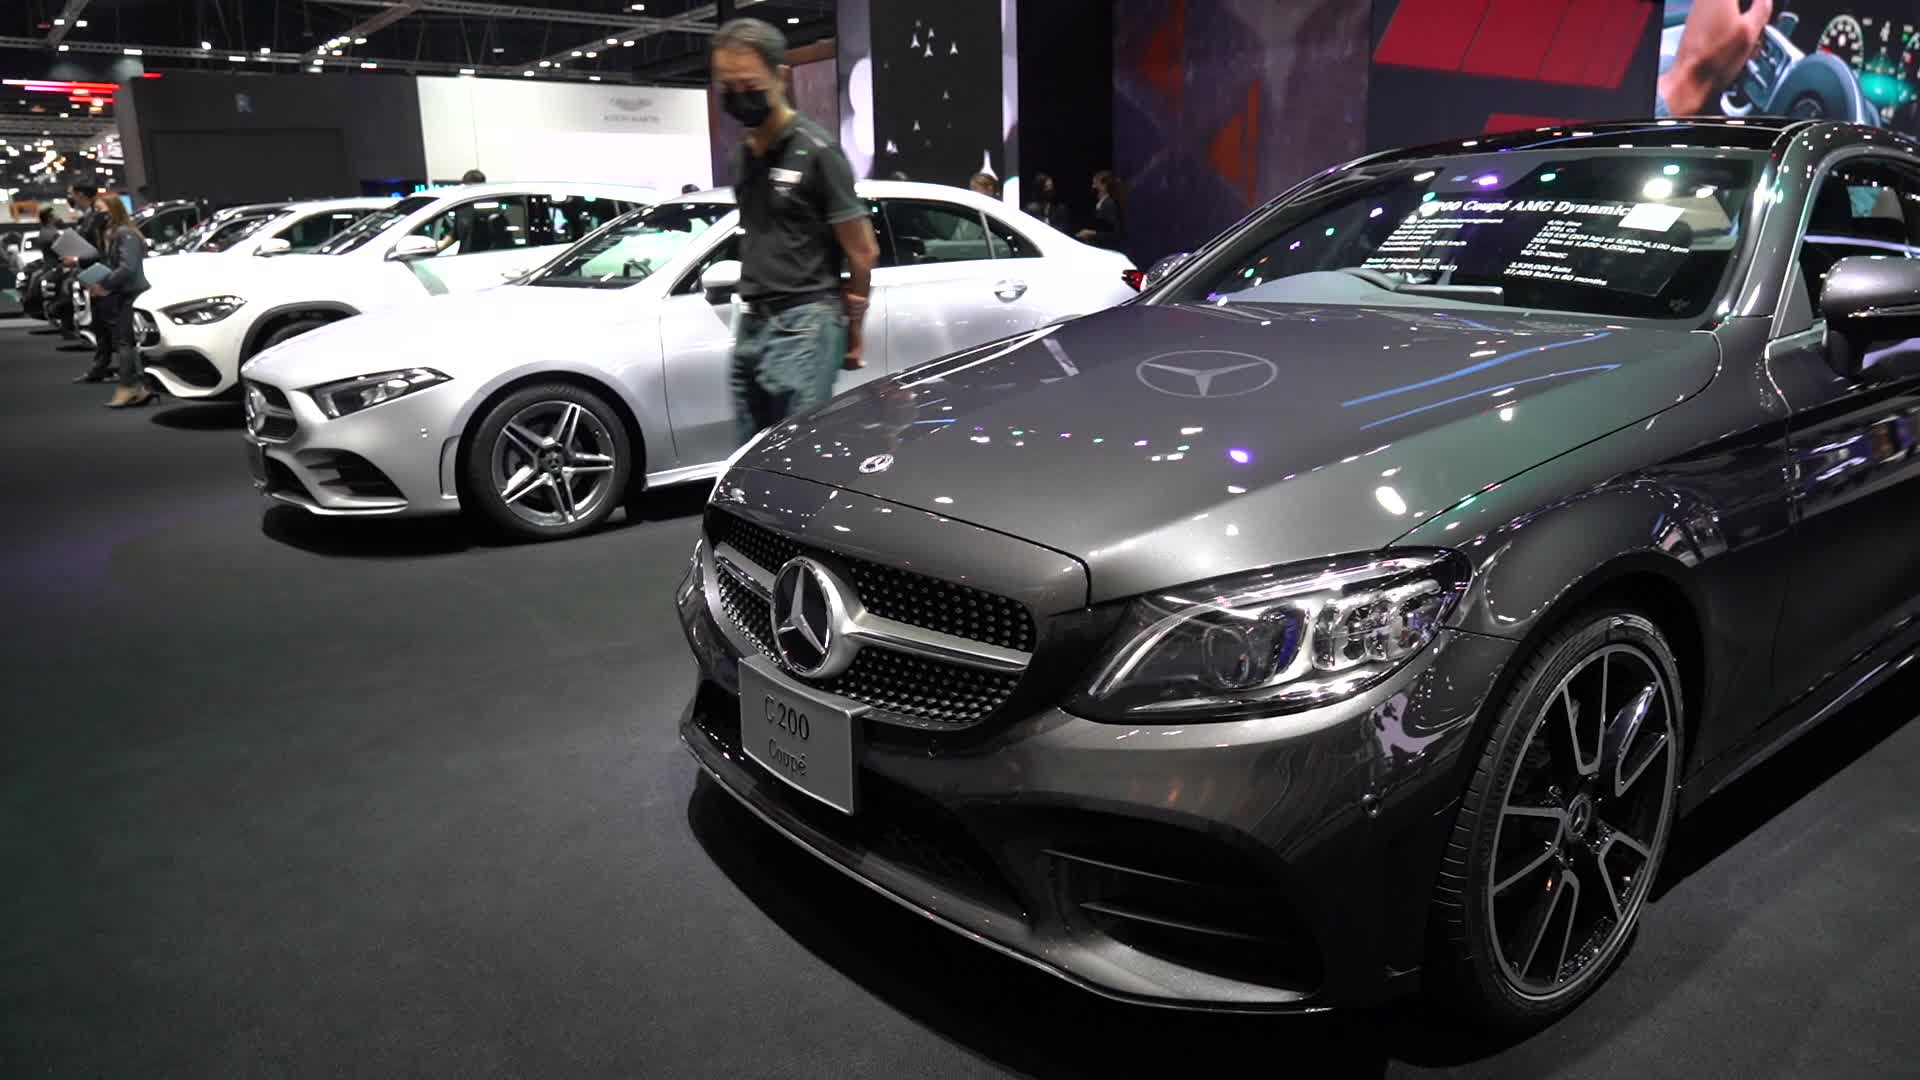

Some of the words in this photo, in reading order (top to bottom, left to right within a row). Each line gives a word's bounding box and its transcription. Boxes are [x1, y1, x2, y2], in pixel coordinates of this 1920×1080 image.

[1510, 200, 1552, 212] AMG
[1553, 201, 1632, 217] Dynamic
[1573, 276, 1608, 287] months
[764, 694, 776, 723] C
[777, 702, 810, 741] 200
[768, 738, 807, 776] Coupé
